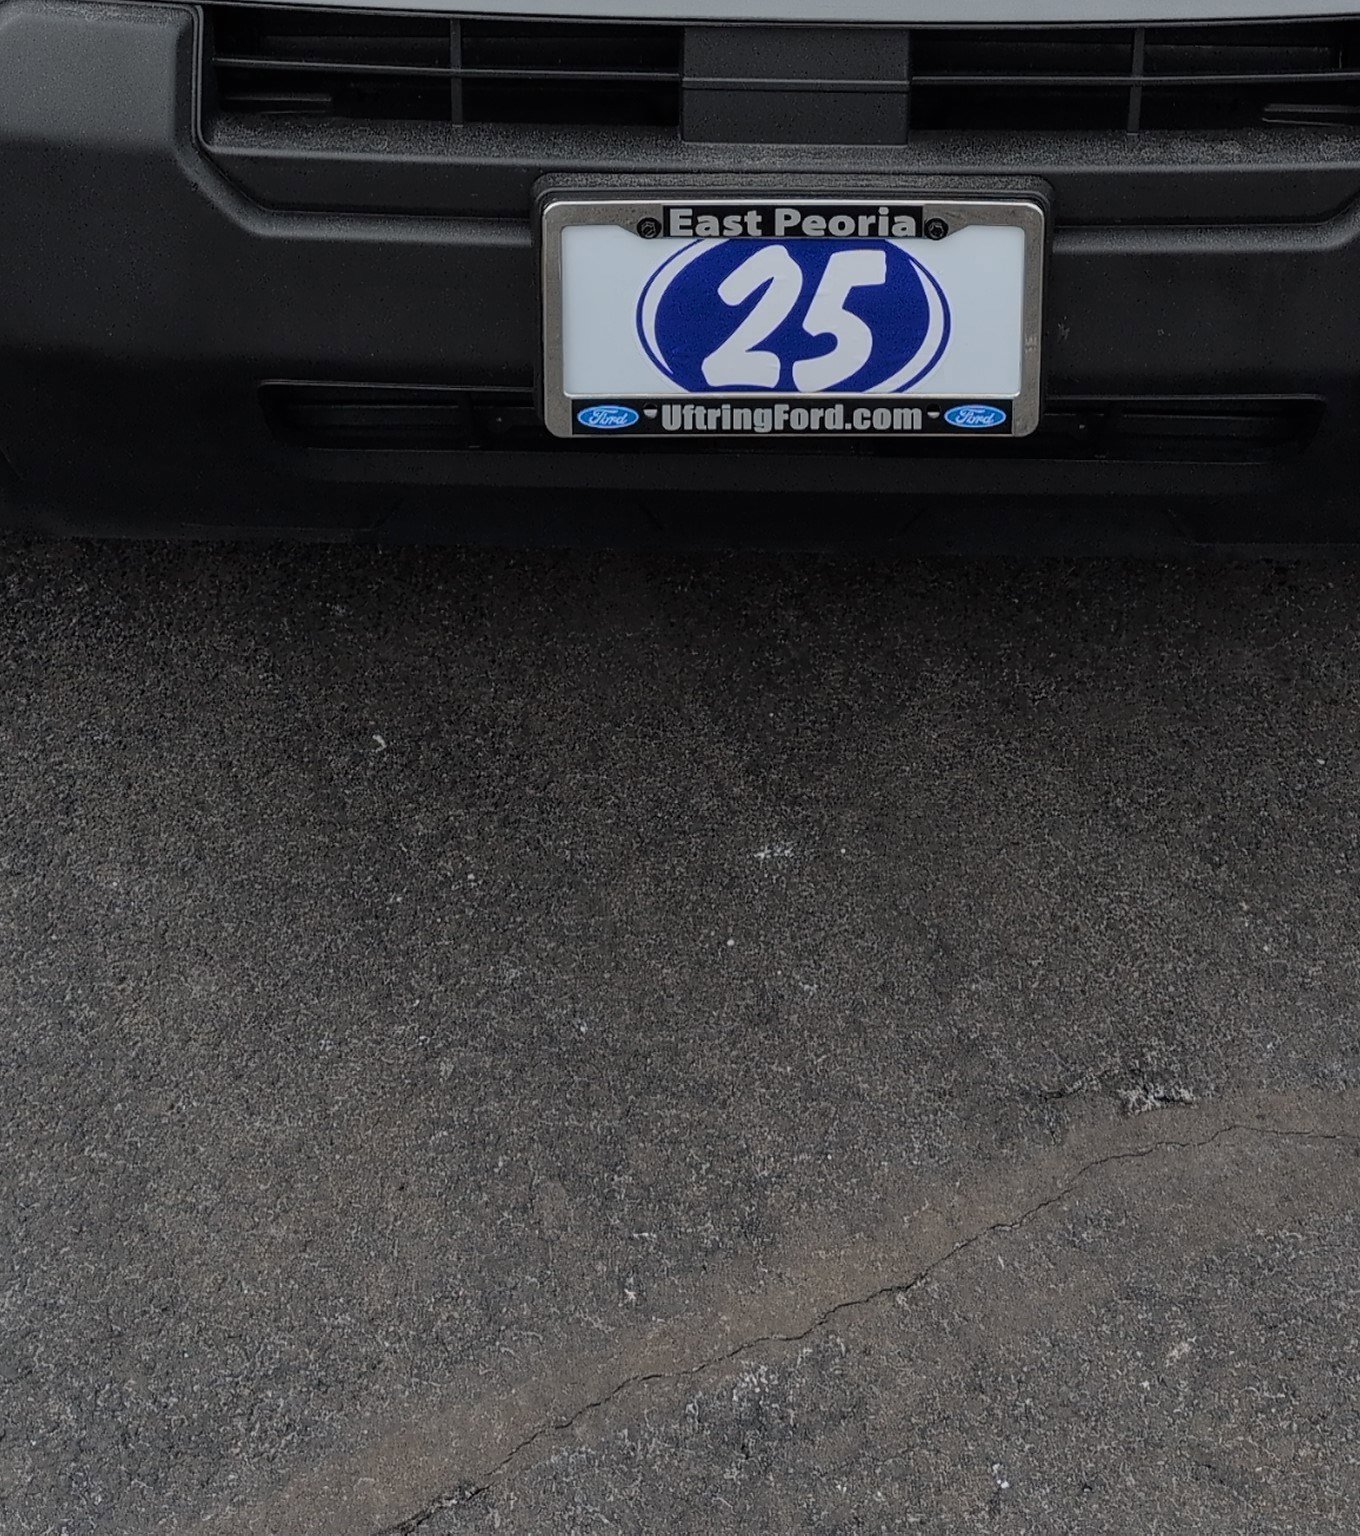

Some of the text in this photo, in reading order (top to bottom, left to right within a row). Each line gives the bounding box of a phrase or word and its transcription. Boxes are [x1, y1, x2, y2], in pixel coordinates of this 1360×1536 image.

[668, 206, 917, 237] East Peoria
[701, 243, 887, 392] 25
[587, 408, 629, 427] Ford
[661, 403, 923, 433] UftringFord.com
[954, 407, 997, 426] Ford
